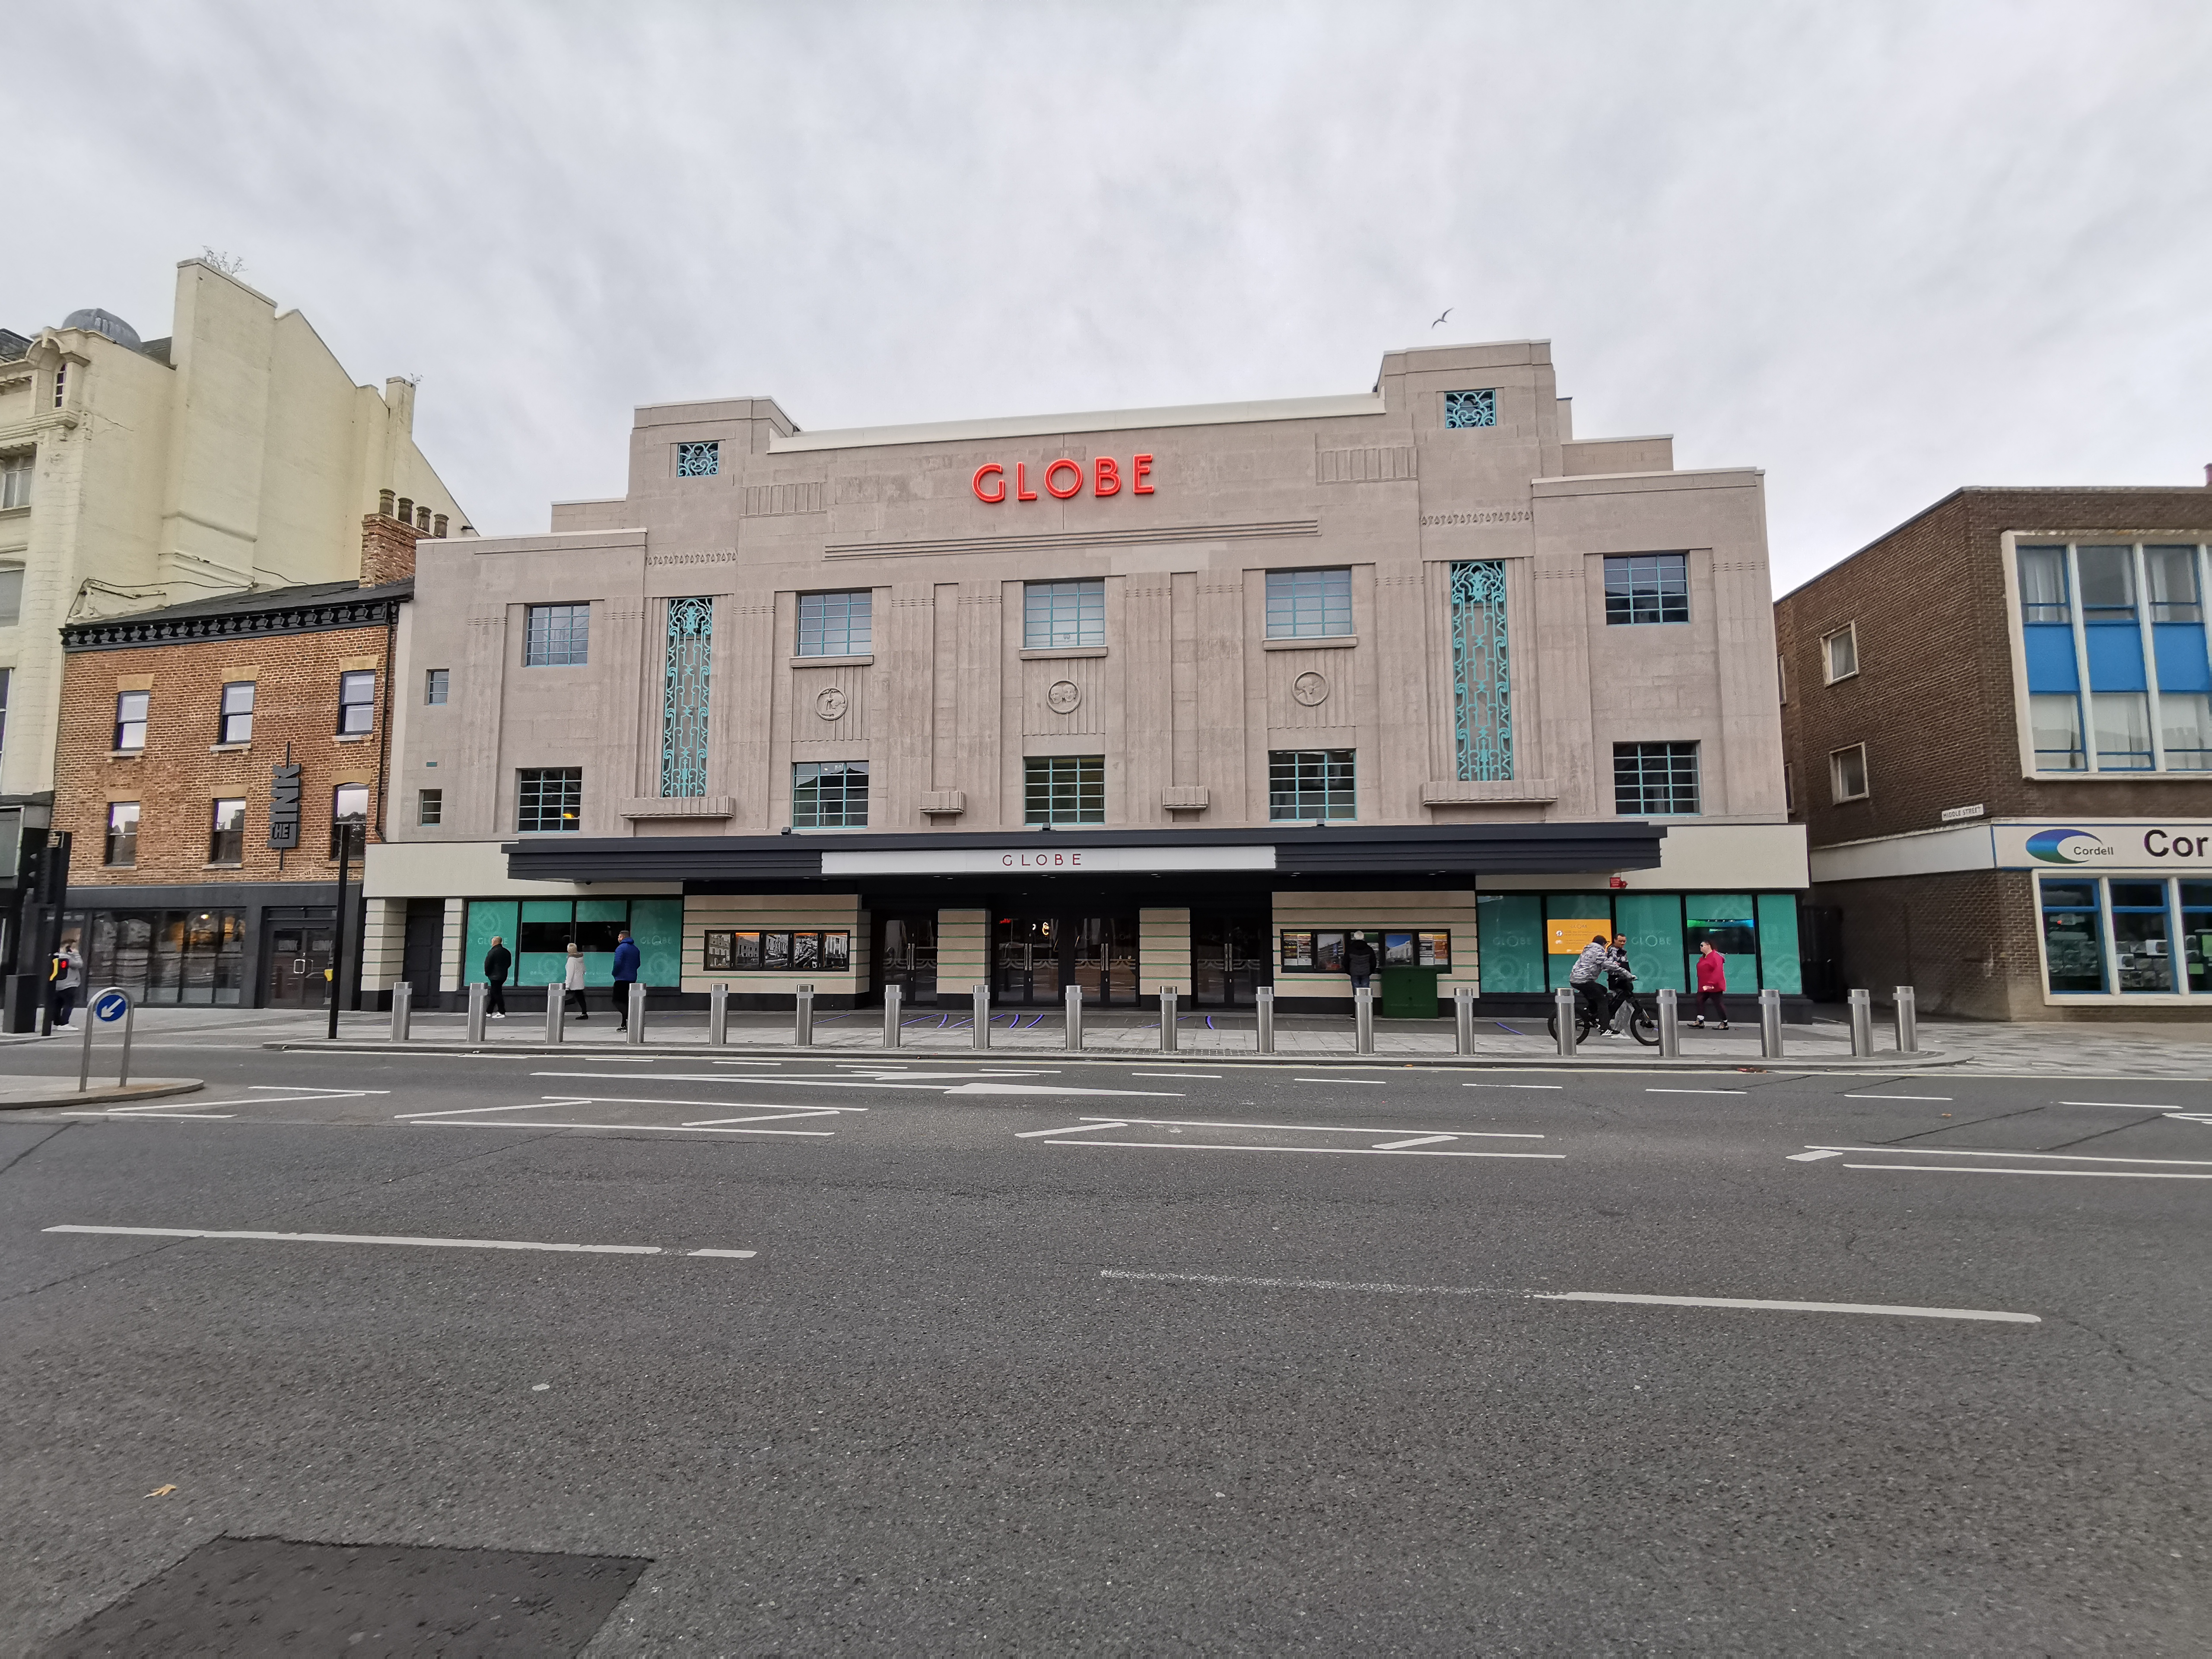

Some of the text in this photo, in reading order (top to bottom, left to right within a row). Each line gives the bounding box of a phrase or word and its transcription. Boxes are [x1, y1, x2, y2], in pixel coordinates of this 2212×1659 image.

[972, 453, 1154, 503] GLOBE
[267, 763, 301, 848] LINK
[1943, 806, 1981, 819] MIDDLE STREET
[269, 823, 289, 839] THE
[2144, 829, 2209, 857] Cor
[2073, 846, 2114, 856] Cordell
[1002, 853, 1081, 866] GLOBE
[477, 936, 508, 946] GLE
[640, 935, 672, 946] GLOBE
[1631, 935, 1672, 947] GLOBE
